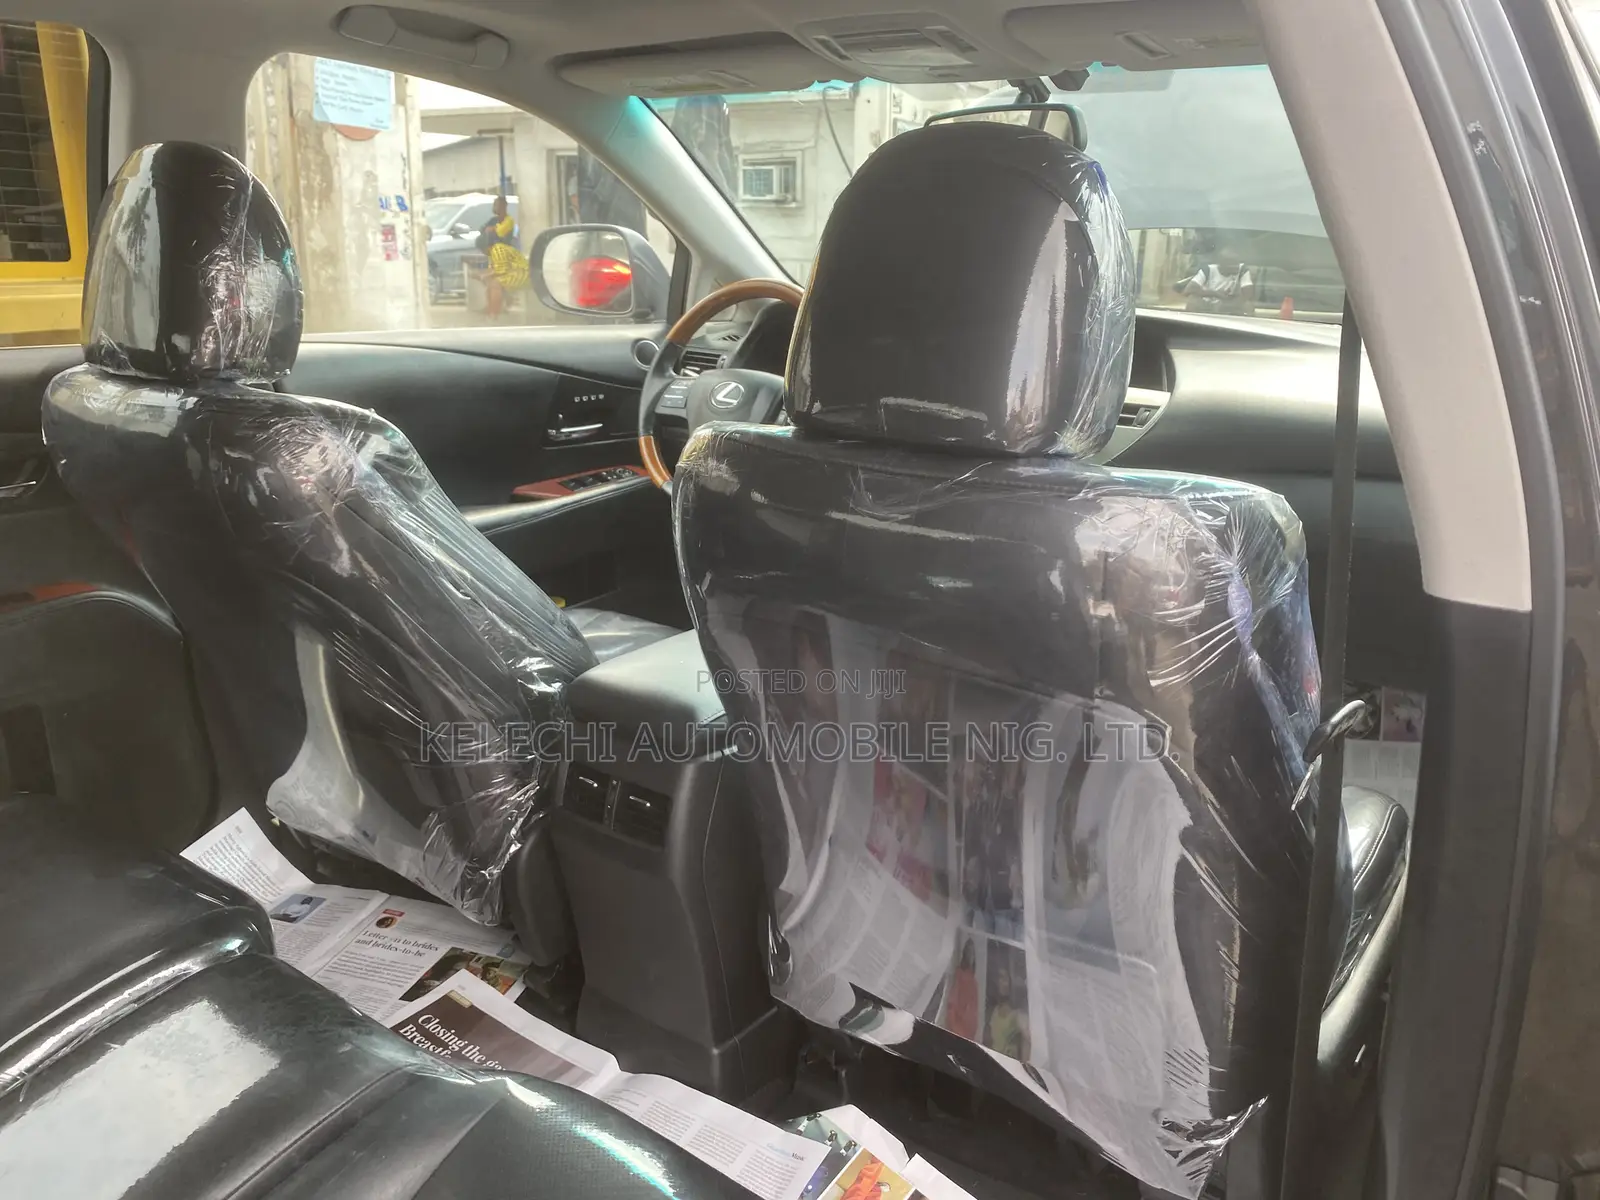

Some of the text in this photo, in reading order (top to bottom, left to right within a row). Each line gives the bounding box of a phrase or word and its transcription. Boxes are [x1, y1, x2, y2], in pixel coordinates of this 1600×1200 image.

[354, 938, 373, 947] and
[371, 938, 427, 957] brides-to-be
[362, 930, 388, 941] Letter
[402, 938, 411, 946] to
[412, 939, 439, 952] brides
[418, 1013, 468, 1052] Closing
[461, 1044, 486, 1064] the
